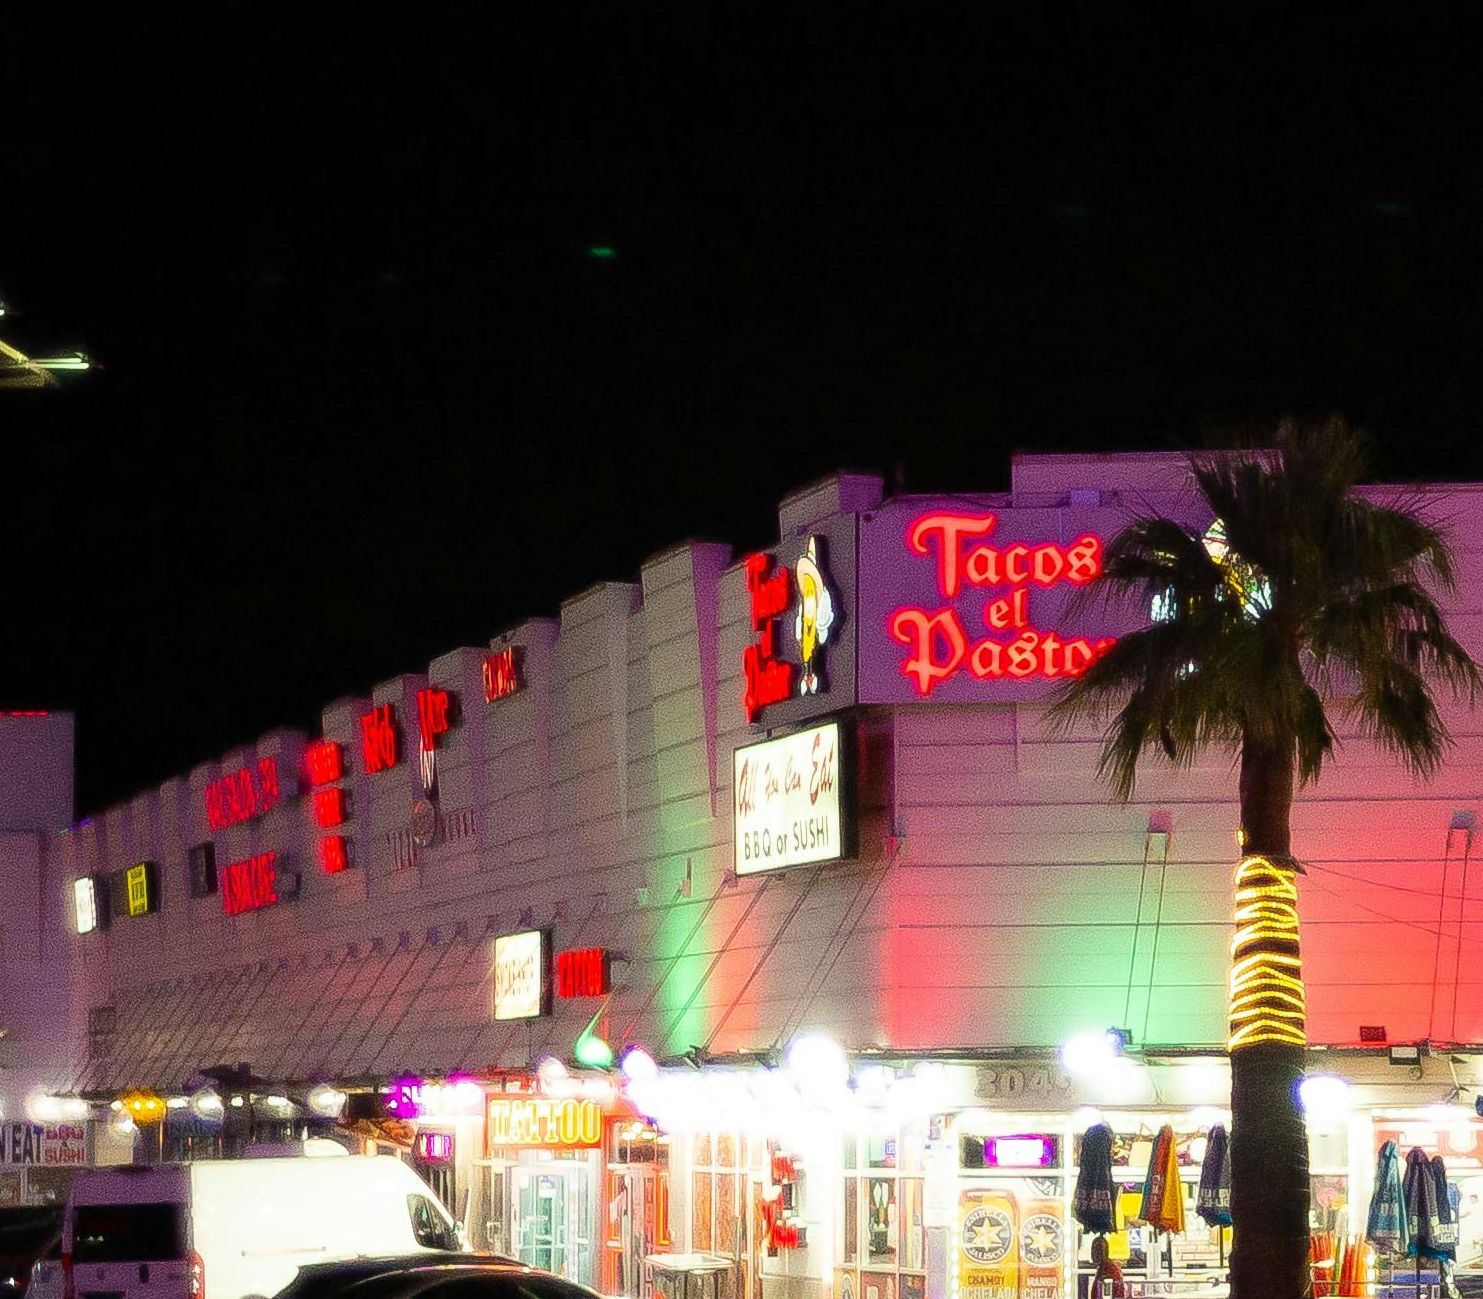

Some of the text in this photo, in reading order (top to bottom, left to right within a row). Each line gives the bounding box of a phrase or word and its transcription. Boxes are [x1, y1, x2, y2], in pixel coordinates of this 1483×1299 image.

[911, 513, 1101, 598] Tacos
[988, 587, 1028, 629] el
[743, 814, 830, 861] BBQ or SUSHI
[11, 1123, 44, 1164] EAT
[489, 1098, 602, 1145] TATTOO
